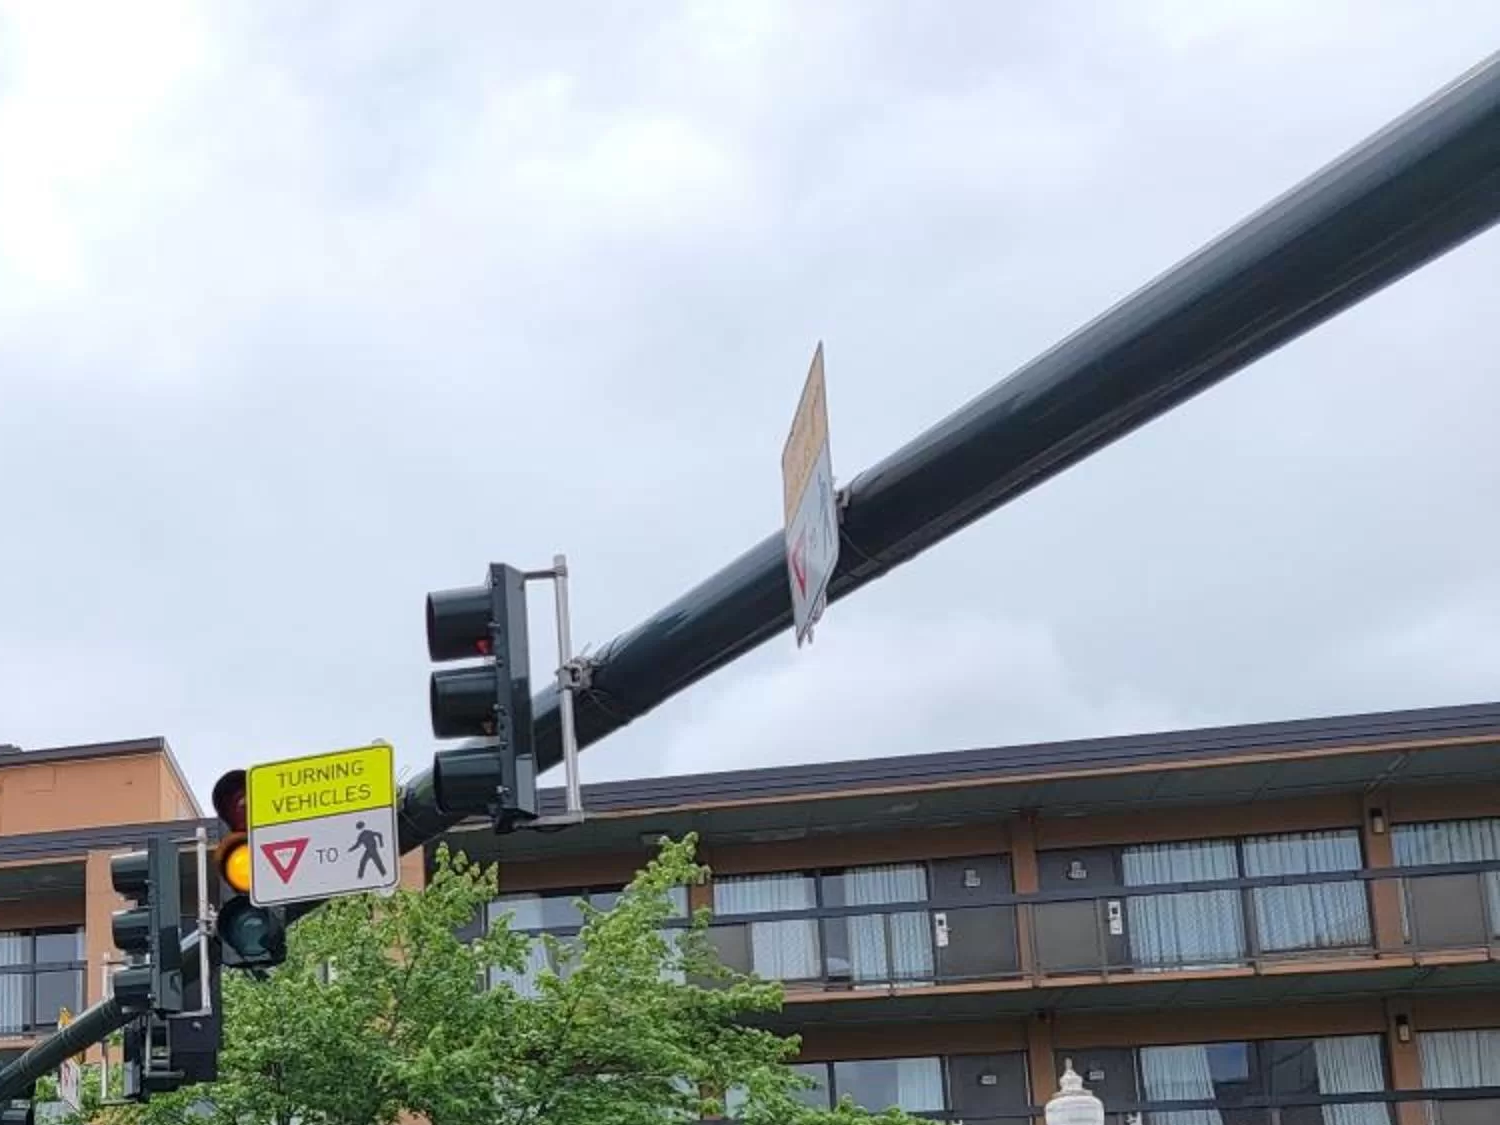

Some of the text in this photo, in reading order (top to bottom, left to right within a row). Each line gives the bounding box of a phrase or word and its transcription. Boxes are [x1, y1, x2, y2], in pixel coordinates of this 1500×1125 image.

[276, 760, 364, 788] TURNING
[272, 784, 371, 814] VEHICLES
[316, 847, 339, 864] TO
